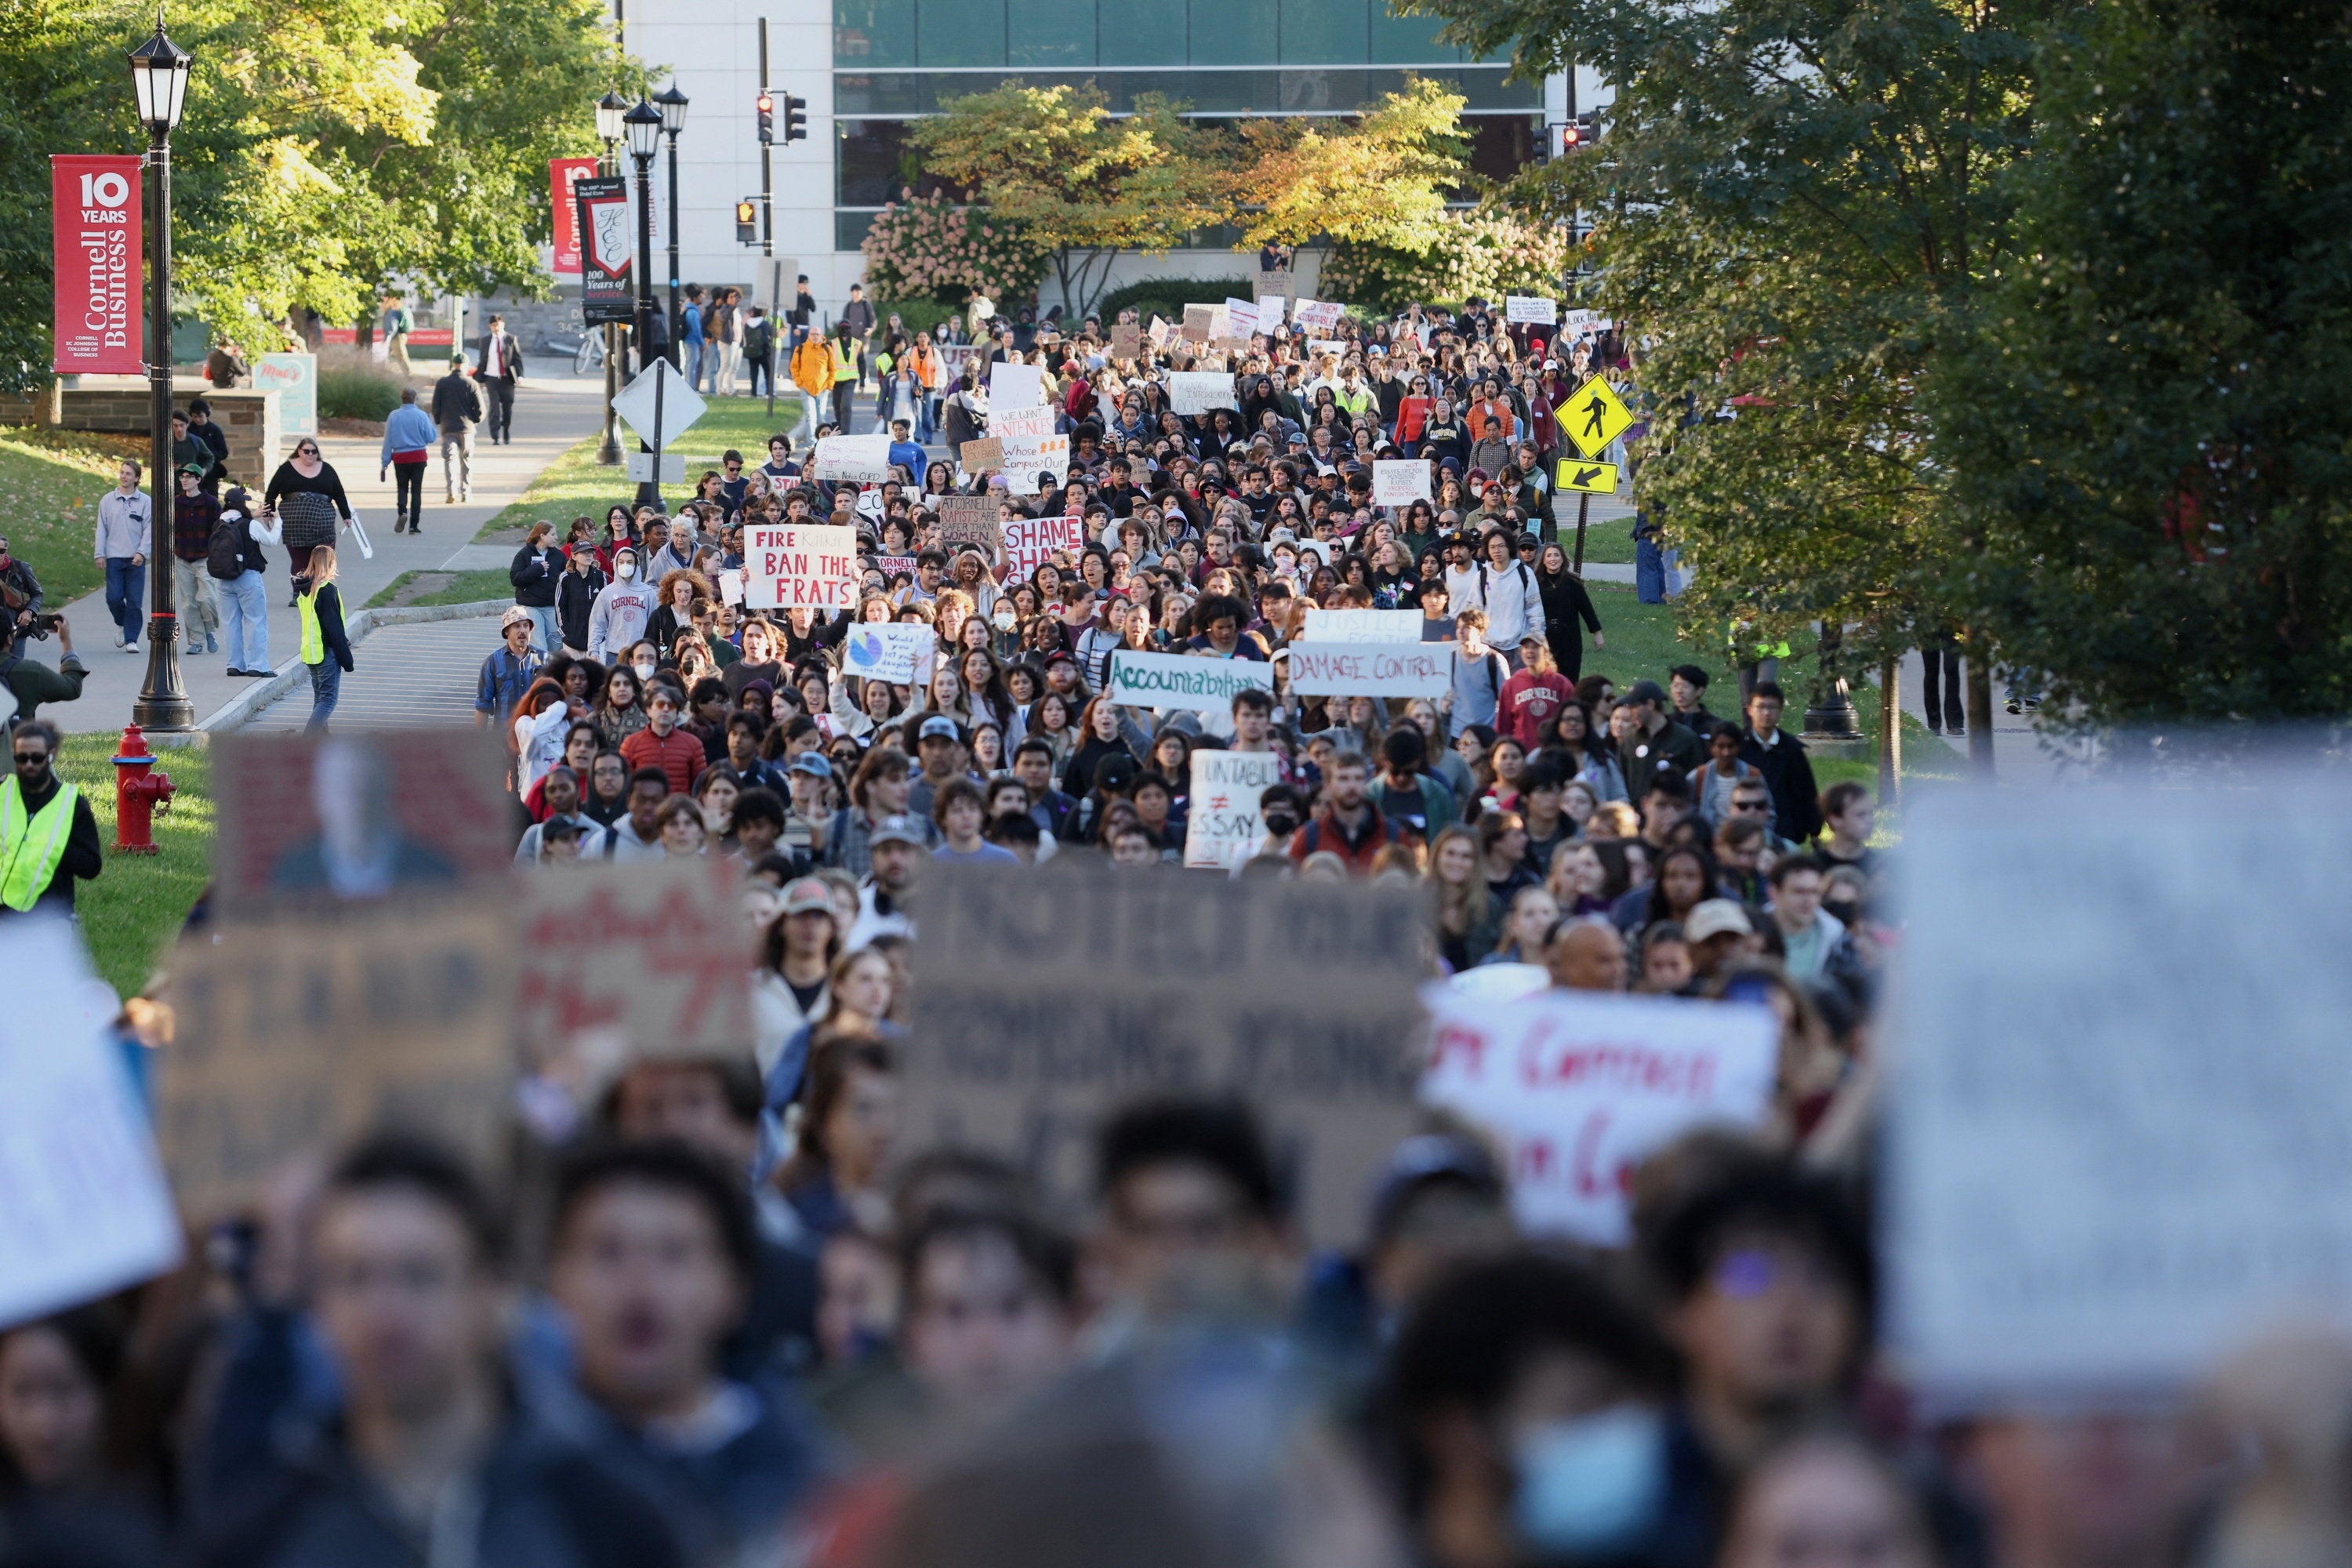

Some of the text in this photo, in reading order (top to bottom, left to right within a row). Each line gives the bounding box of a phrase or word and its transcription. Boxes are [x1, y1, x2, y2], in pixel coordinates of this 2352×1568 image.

[80, 172, 129, 208] 10
[81, 210, 127, 223] YEARS
[81, 230, 107, 331] Cornell
[587, 270, 604, 280] 100
[105, 229, 126, 348] Business
[587, 278, 627, 291] Years of
[1319, 303, 1338, 315] THEM
[1569, 314, 1585, 325] LOCK
[1000, 408, 1044, 422] WE WANT
[989, 416, 1054, 437] SENTENCES
[1001, 445, 1036, 456] Whose
[1003, 457, 1044, 470] Campus?
[1044, 457, 1065, 469] Our
[823, 470, 839, 480] Take
[842, 471, 858, 480] Notes
[942, 497, 956, 510] AT
[942, 510, 996, 523] RAPISTS ARE
[942, 522, 994, 532] SAFER THAN
[1005, 518, 1081, 548] SHAME
[756, 532, 796, 547] FIRE
[765, 553, 850, 577] BAN THE
[776, 579, 851, 604] FRATS
[612, 596, 645, 610] CORNELL
[887, 633, 913, 643] Would
[1293, 652, 1448, 682] DAMAGE CONTROL
[1515, 687, 1560, 706] CORNELL
